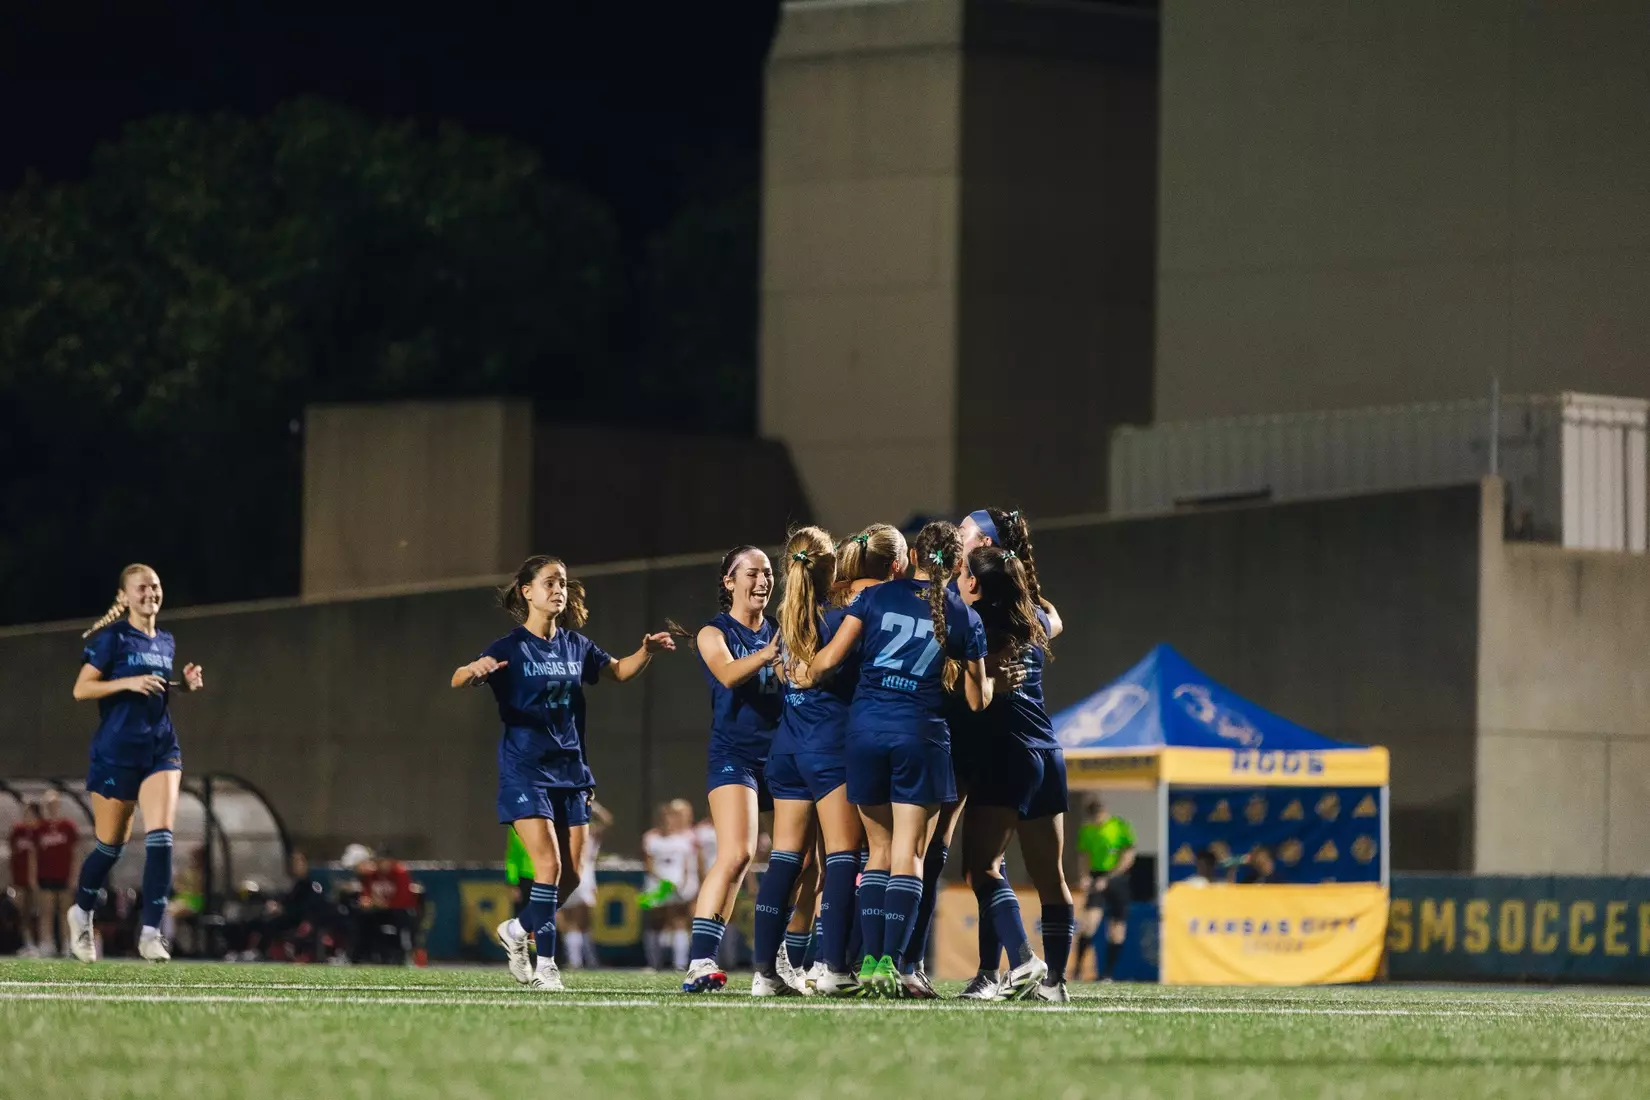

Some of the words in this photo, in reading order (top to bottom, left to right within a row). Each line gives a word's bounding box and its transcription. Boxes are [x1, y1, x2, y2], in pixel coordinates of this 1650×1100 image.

[873, 612, 952, 677] 27
[523, 661, 566, 676] KANSAS
[881, 674, 918, 691] ROOS
[546, 680, 572, 708] 24
[756, 904, 779, 915] ROOS
